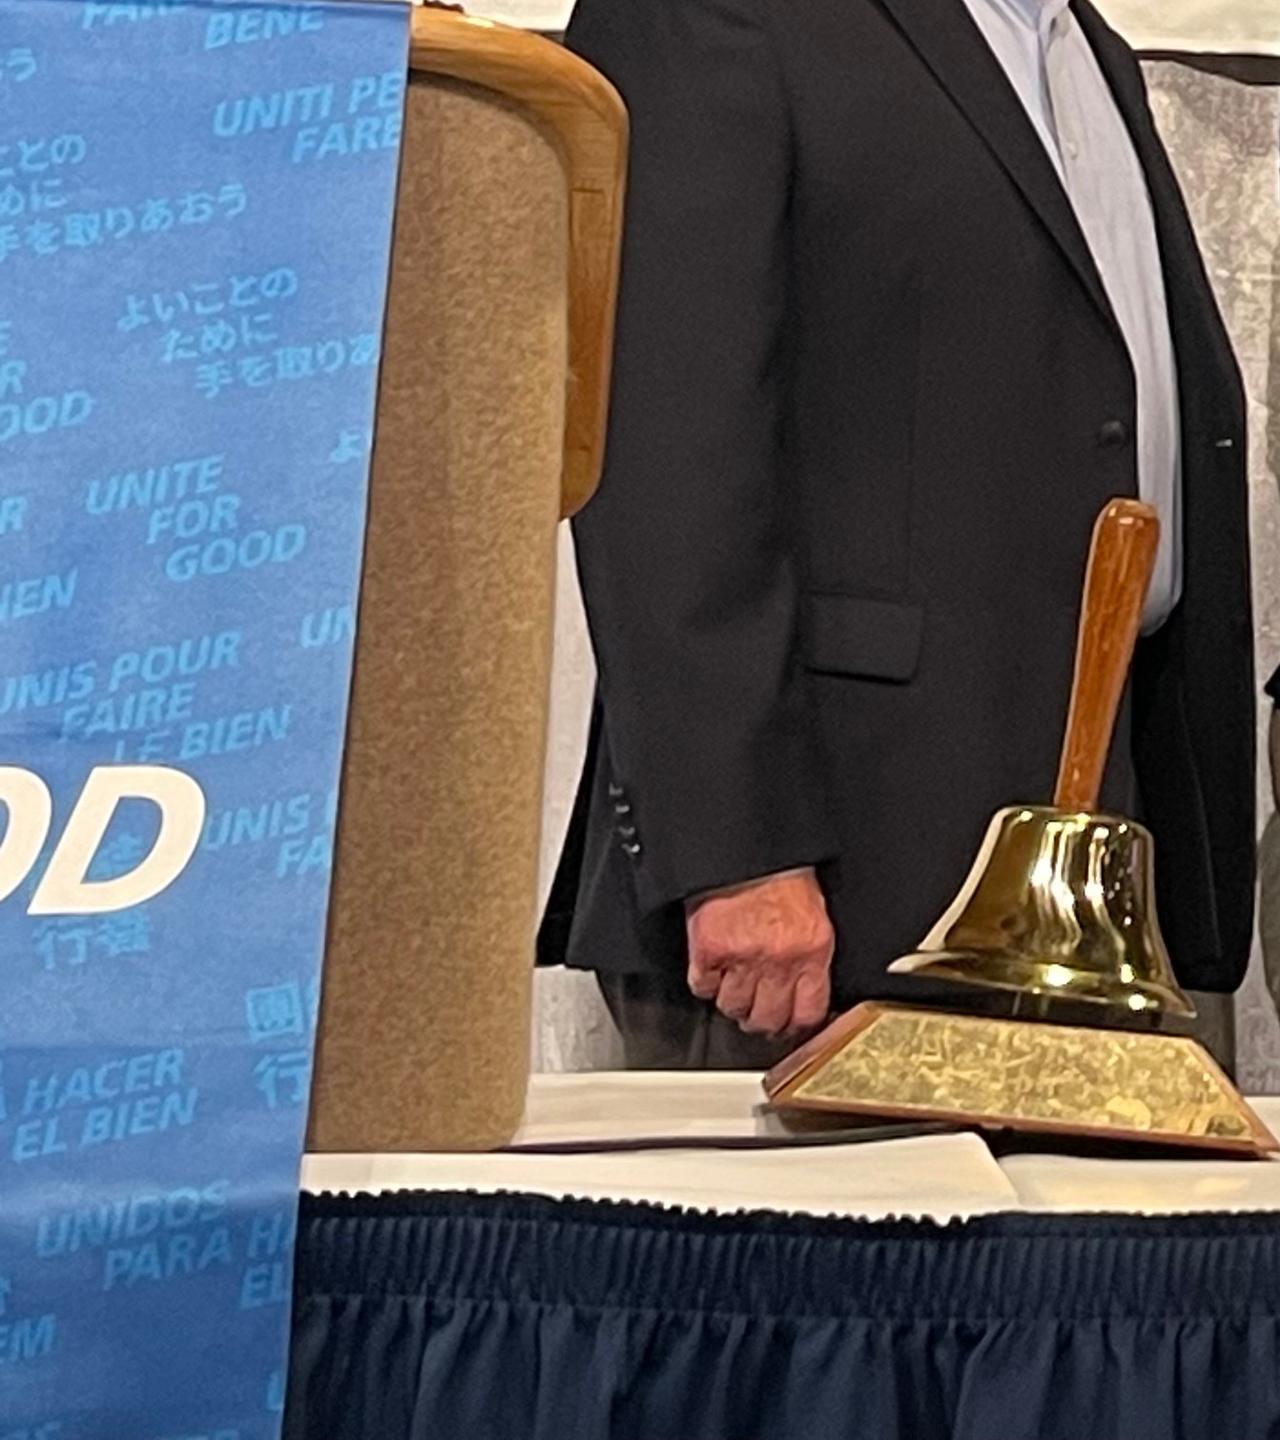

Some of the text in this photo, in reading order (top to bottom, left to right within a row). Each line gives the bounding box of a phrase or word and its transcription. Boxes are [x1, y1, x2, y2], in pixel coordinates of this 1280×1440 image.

[212, 83, 335, 137] UNITI
[117, 267, 299, 331] よいことの
[160, 312, 278, 364] ために
[85, 452, 226, 515] UNITE
[146, 493, 242, 545] FOR
[165, 524, 306, 582] GOOD
[107, 630, 242, 693] POUR
[60, 681, 198, 744] FAIRE
[178, 702, 292, 762] BIEN
[23, 1047, 185, 1116] HACER
[12, 1087, 200, 1163] EL BIEN
[34, 1178, 231, 1257] UNIDOS
[103, 1225, 234, 1292] PARA
